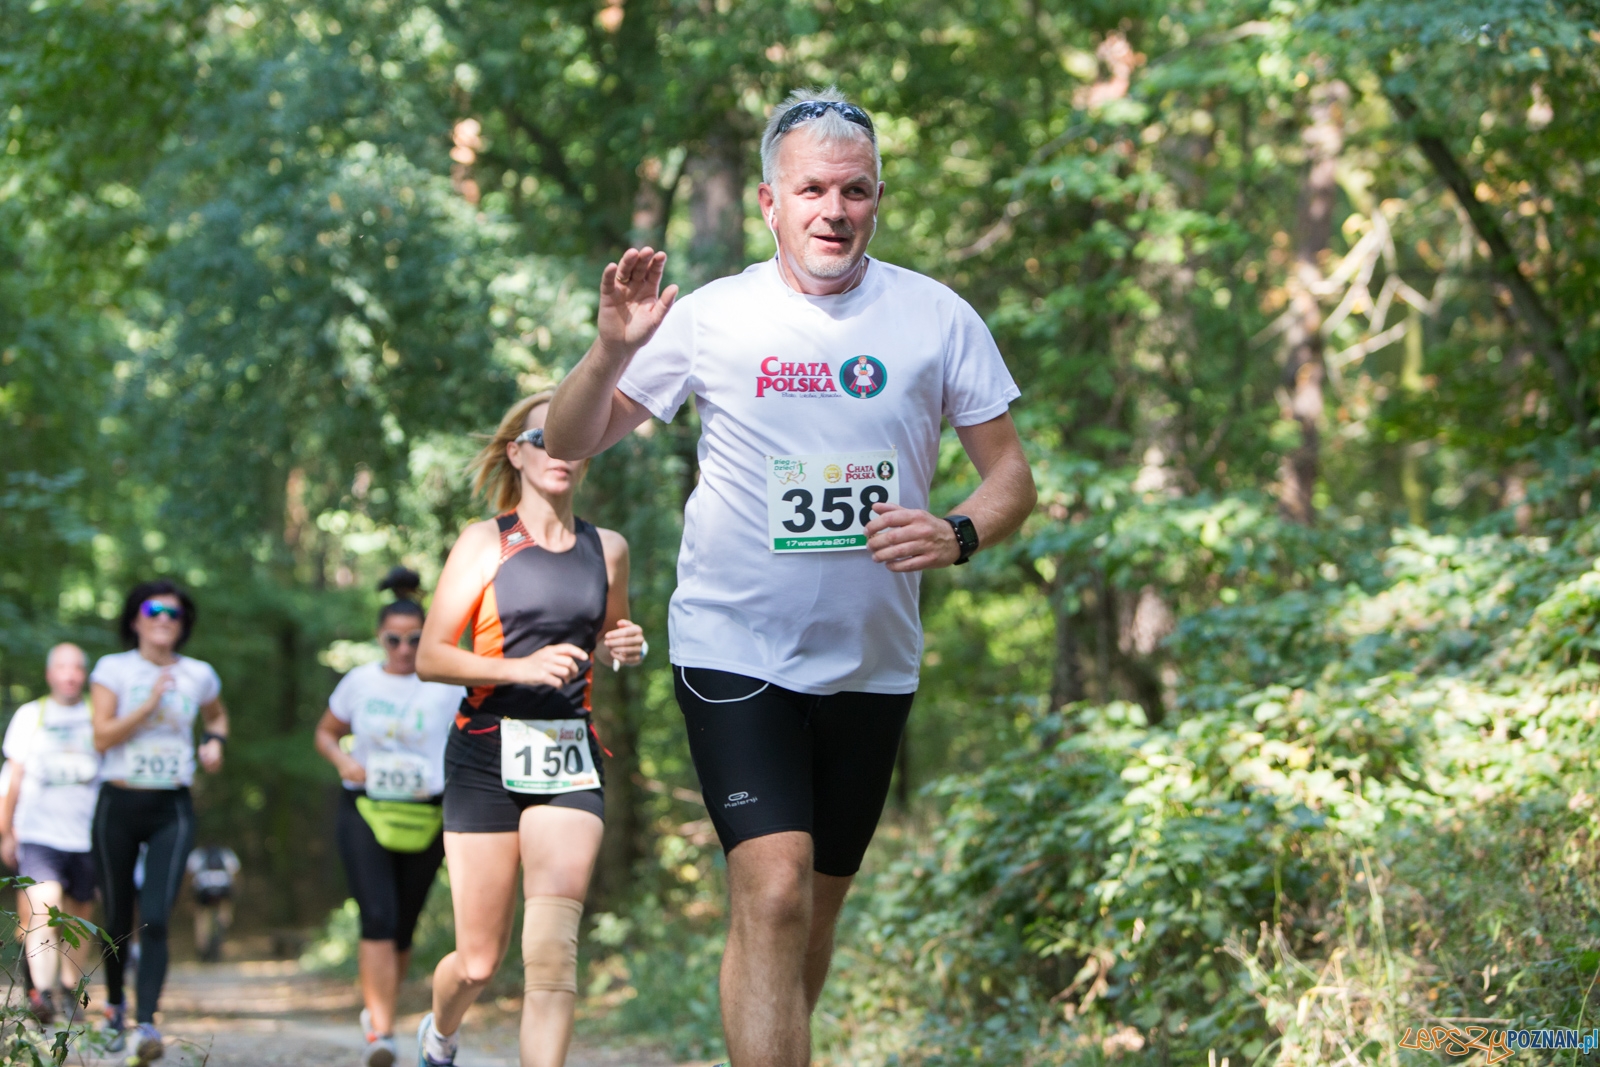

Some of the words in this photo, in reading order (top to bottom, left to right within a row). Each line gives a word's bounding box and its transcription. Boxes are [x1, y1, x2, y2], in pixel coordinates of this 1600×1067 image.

[760, 355, 833, 377] CHATA
[755, 376, 837, 398] POLSKA
[845, 472, 876, 483] POLSKA
[846, 463, 874, 473] CHATA
[781, 484, 889, 533] 358
[132, 754, 180, 776] 202
[515, 744, 584, 777] 150
